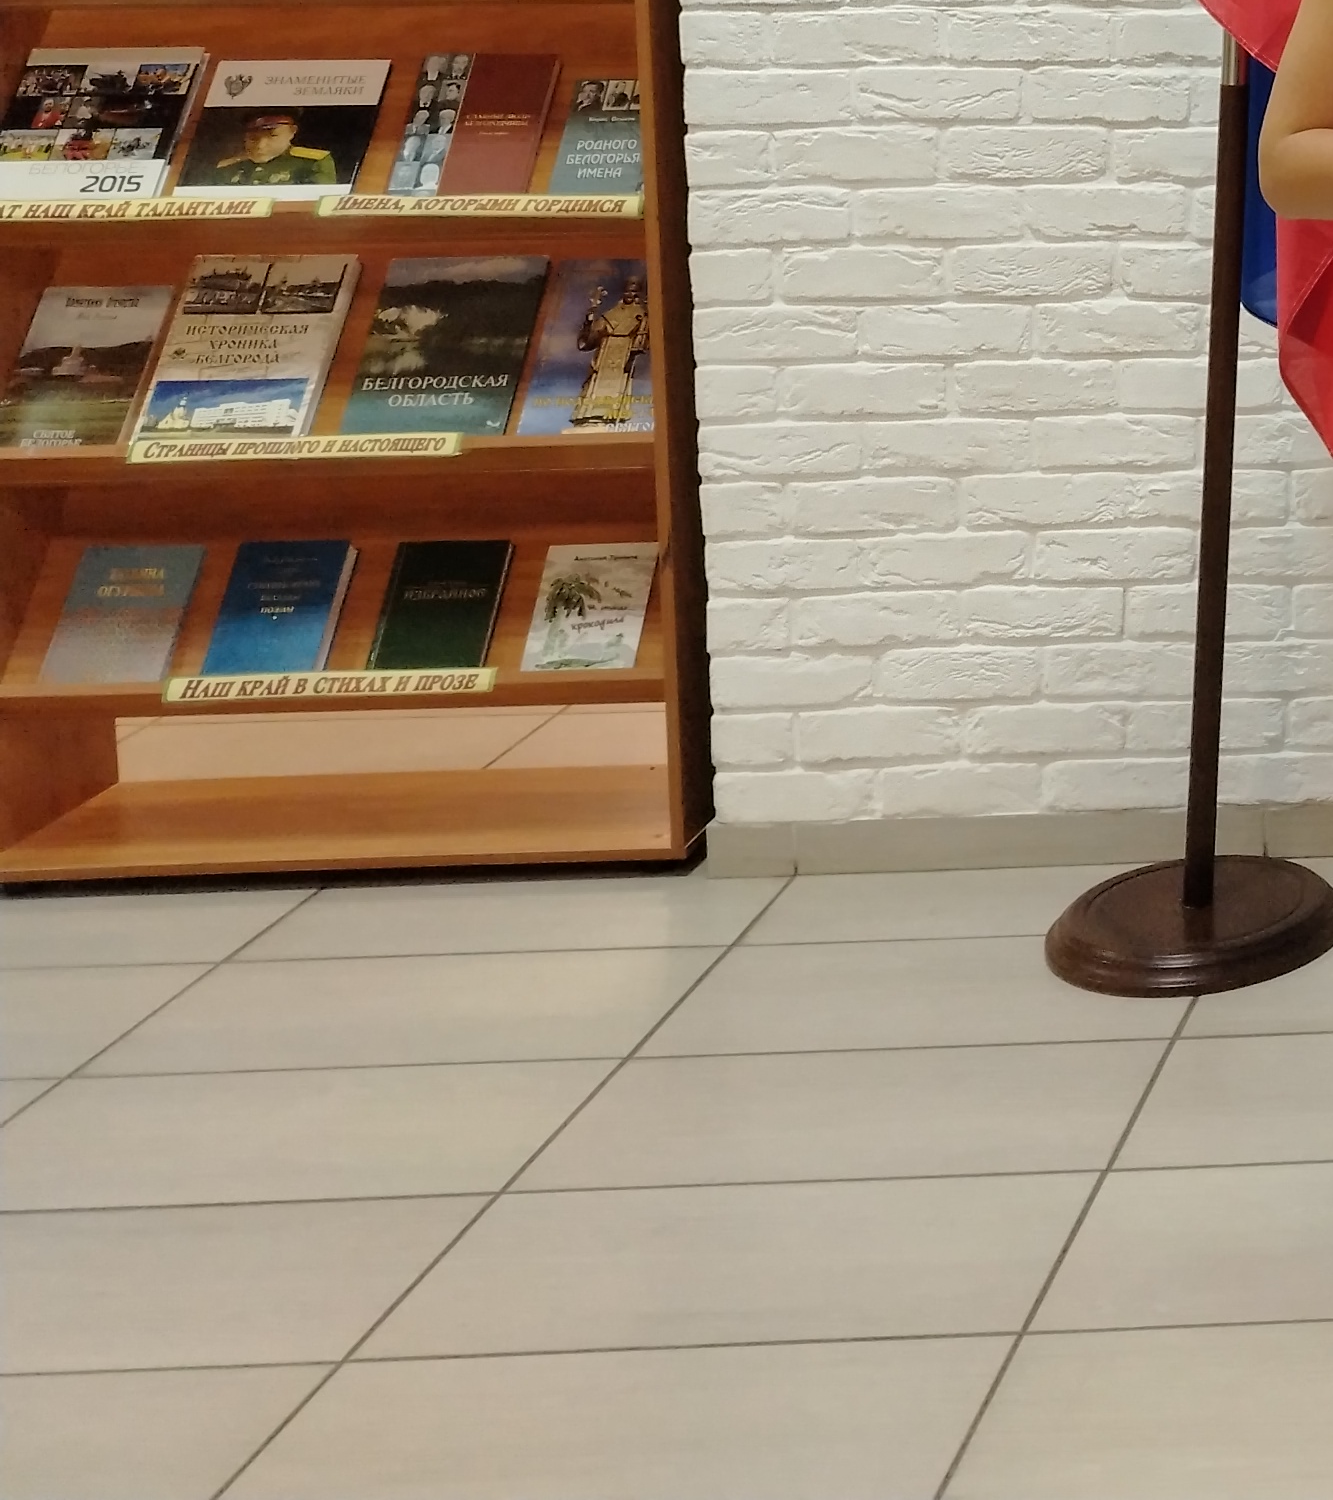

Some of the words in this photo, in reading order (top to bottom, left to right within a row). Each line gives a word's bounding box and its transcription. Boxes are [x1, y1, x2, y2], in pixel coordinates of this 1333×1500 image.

[264, 75, 367, 86] ЗНАМЕНИТЫЕ
[293, 87, 365, 97] ЗЕМЛЯКИ
[576, 139, 638, 152] РОДНОГО
[566, 152, 641, 165] БЕЛОГОРЬЯ
[577, 167, 622, 179] ИМЕНА
[80, 175, 144, 193] 2015
[23, 203, 77, 219] НАШ
[77, 202, 134, 218] КРАЙ
[135, 200, 258, 218] ТАЛАНТАМИ
[518, 198, 627, 214] ГОРДИМСЯ
[185, 324, 310, 336] ИСТОРИЧЕСКАЯ
[208, 338, 279, 351] ХРОНИКА
[195, 352, 281, 365] БЕЛГОРОДА
[362, 373, 509, 391] БЕЛГОРОДСКАЯ
[388, 392, 475, 408] ОБЛАСТЬ
[143, 441, 232, 459] СТРАНИЦЫ
[232, 440, 319, 456] ПРОШЛОГО
[338, 436, 447, 455] НАСТОЯЩЕГО
[180, 677, 231, 699] НАШ
[235, 675, 291, 698] КРАЙ
[313, 674, 387, 694] СТИХАХ
[411, 673, 480, 692] ПРОЗЕ
